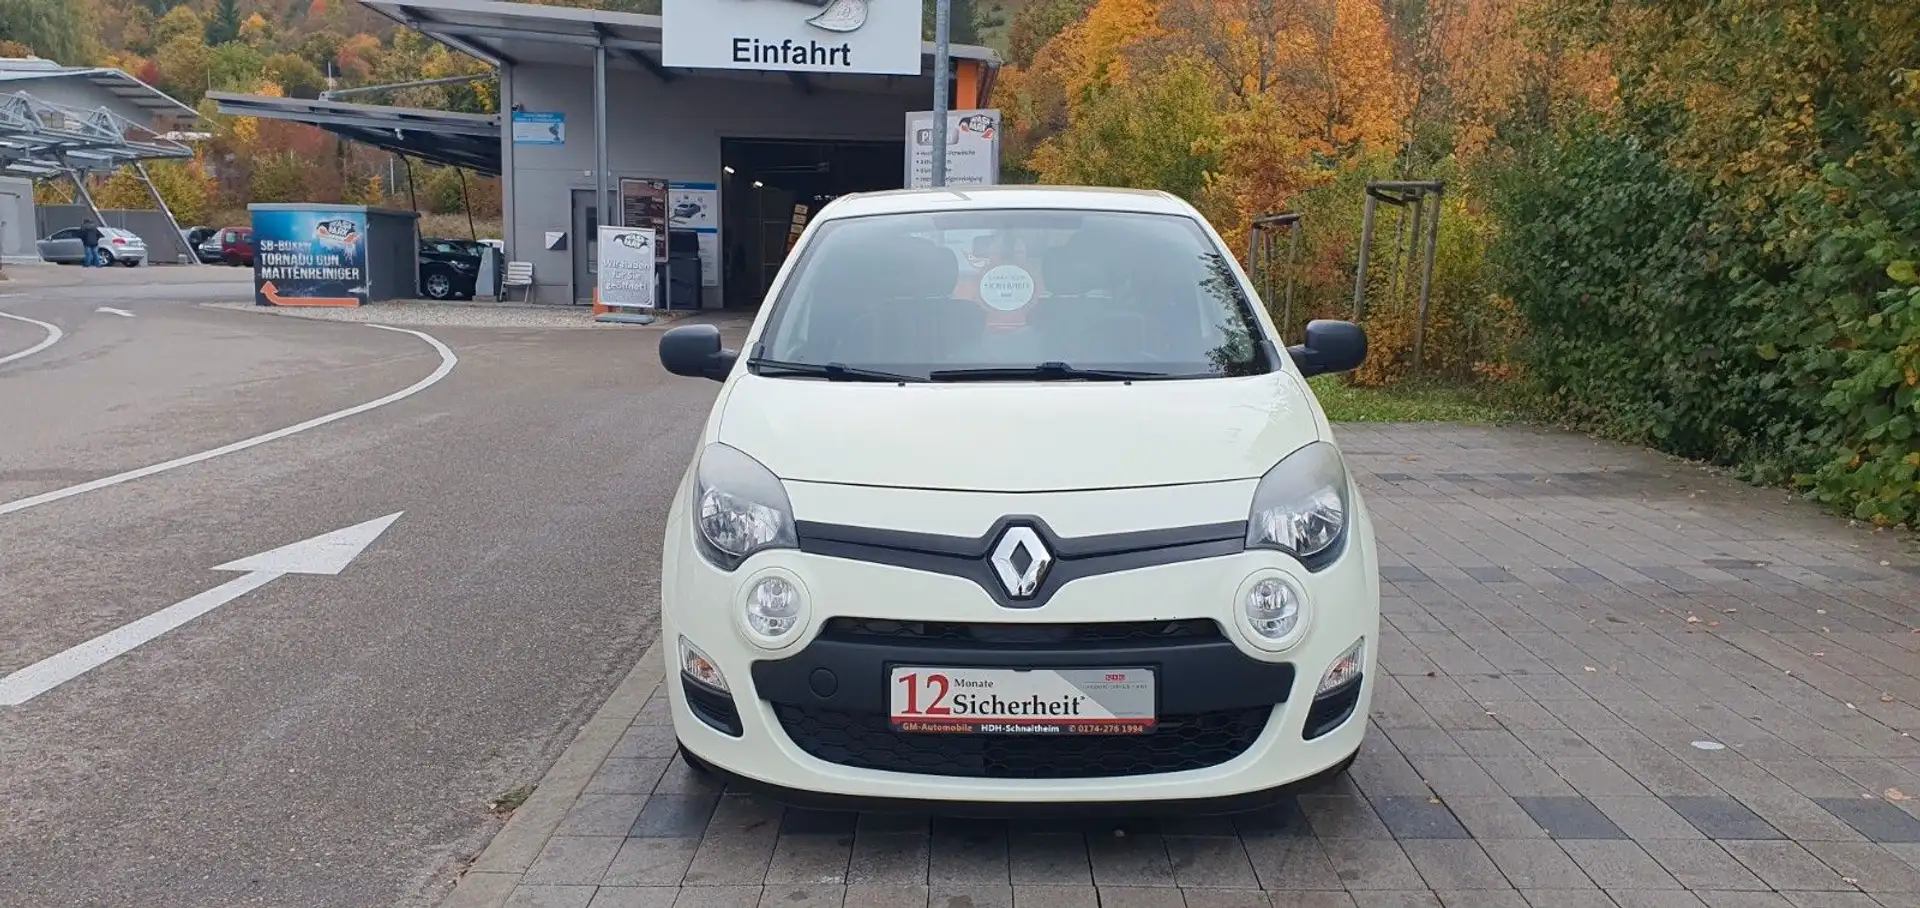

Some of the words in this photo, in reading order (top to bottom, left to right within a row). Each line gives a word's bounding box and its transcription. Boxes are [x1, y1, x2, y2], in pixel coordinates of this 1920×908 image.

[733, 37, 851, 66] Einfahrt
[260, 252, 313, 266] TORNADO
[261, 266, 360, 280] MATTENREINIGER
[954, 678, 994, 688] Monate
[898, 672, 950, 715] 12
[903, 722, 972, 732] GM-Automobile
[981, 724, 1059, 733] HDH-Schnaitheim
[1078, 724, 1119, 733] 0174-276
[1122, 724, 1143, 733] 1994
